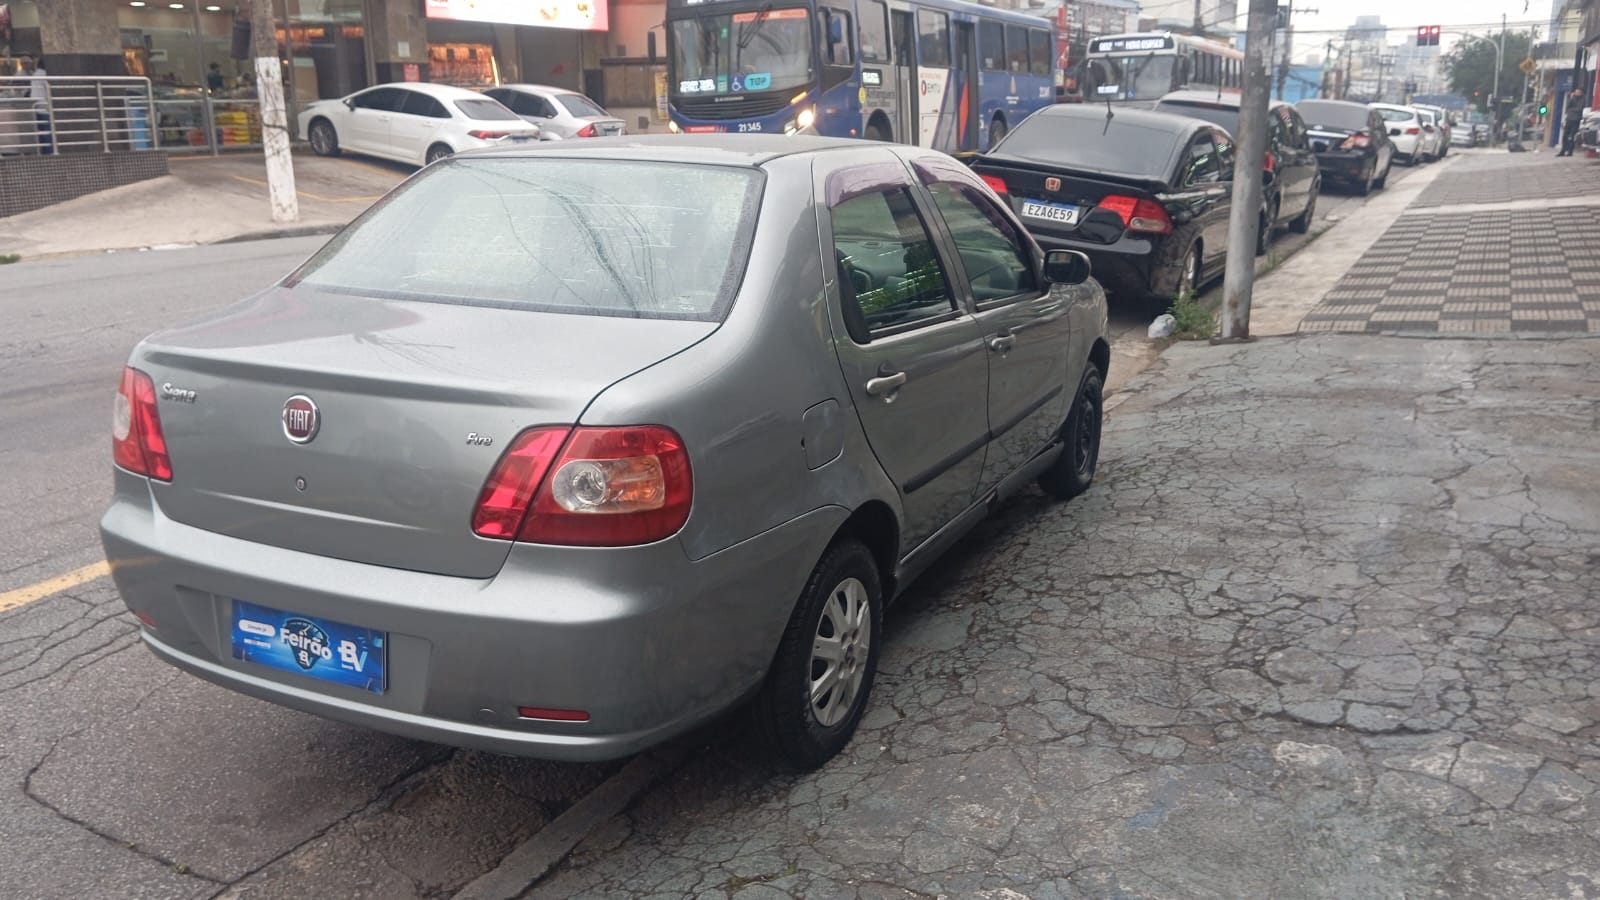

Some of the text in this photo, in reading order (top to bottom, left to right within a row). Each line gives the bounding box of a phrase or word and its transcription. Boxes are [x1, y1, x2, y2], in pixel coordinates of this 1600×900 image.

[749, 77, 767, 86] TOP
[1027, 204, 1073, 221] EZA6E59
[289, 408, 311, 431] FIAT
[466, 432, 493, 447] Fire
[280, 627, 333, 661] Feirão
